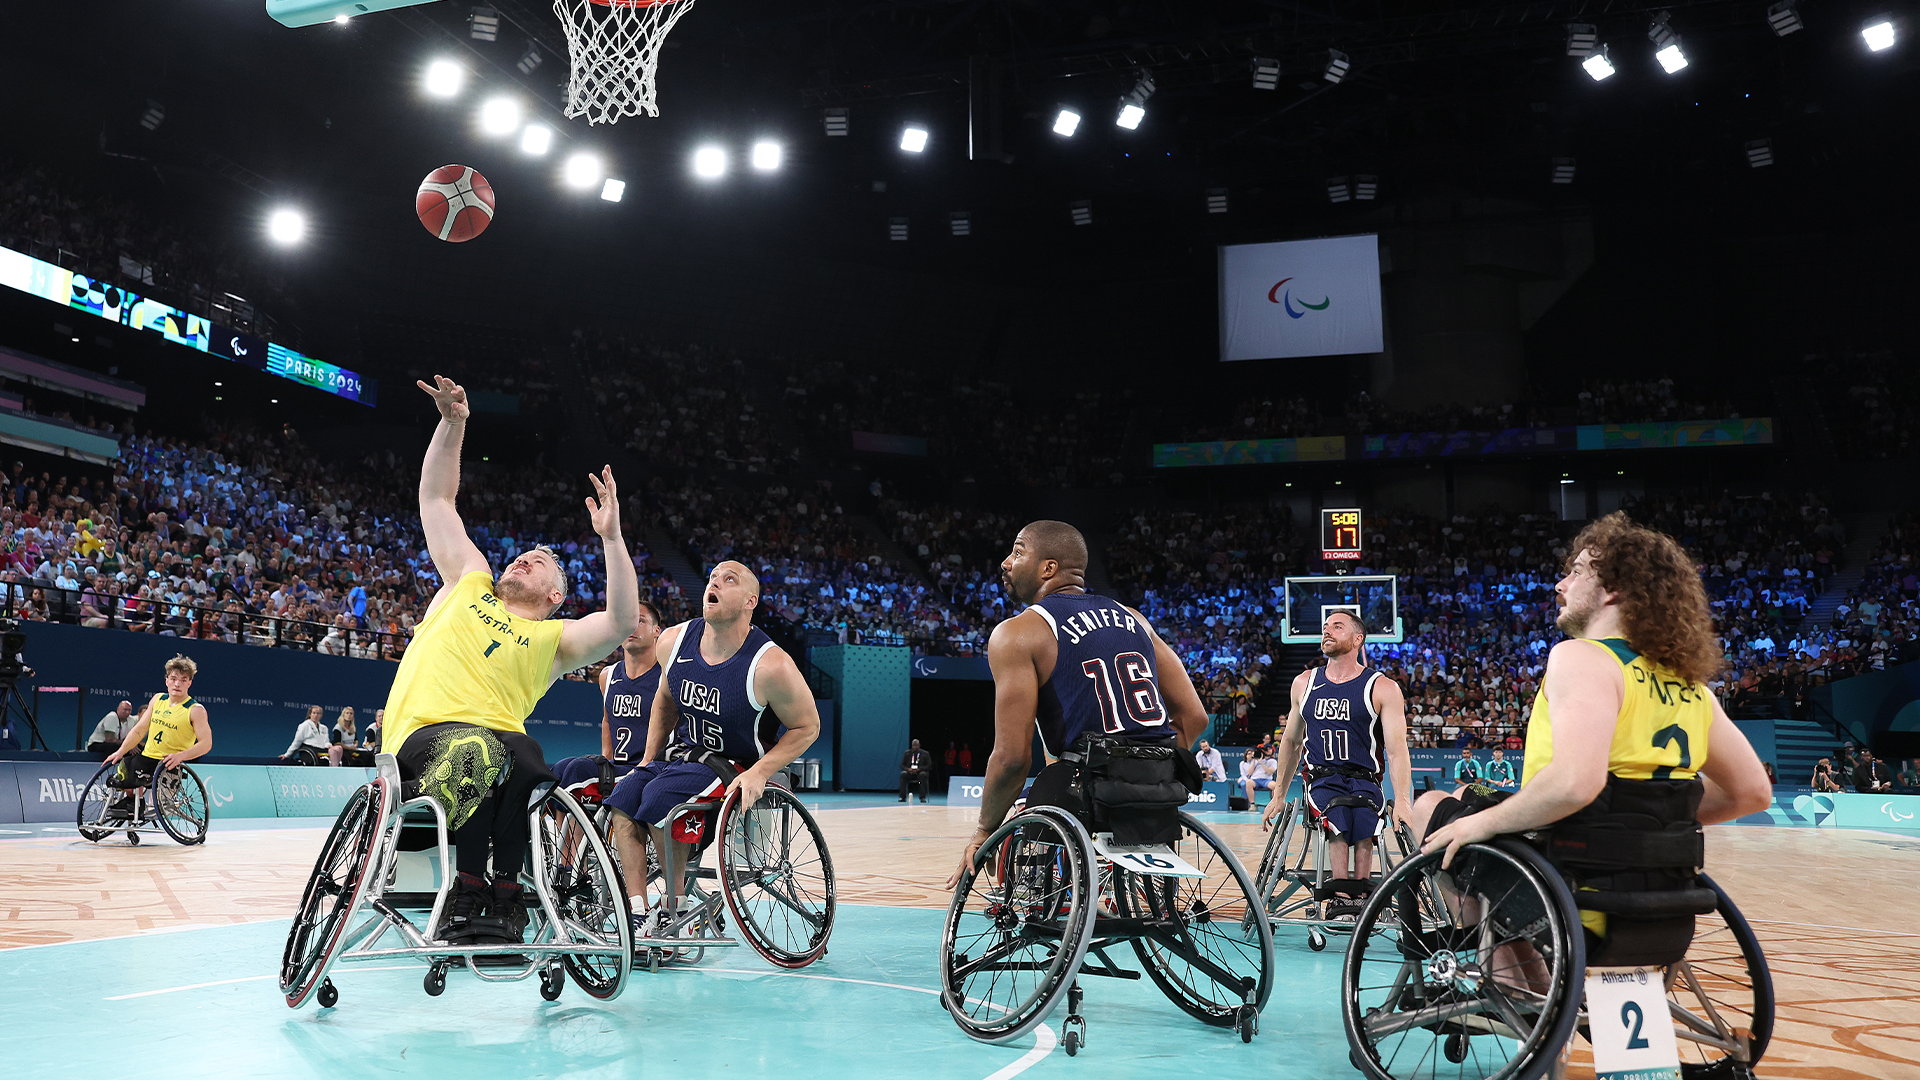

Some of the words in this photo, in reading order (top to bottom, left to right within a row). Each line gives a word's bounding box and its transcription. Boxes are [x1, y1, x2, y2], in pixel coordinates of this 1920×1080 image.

[285, 357, 325, 382] PARIS
[328, 372, 362, 394] 2024
[1331, 513, 1358, 525] 5:08
[1336, 527, 1357, 547] 17
[469, 604, 530, 649] AUSTRAIA
[1061, 608, 1136, 645] JENIFER
[483, 639, 501, 658] 1
[679, 679, 720, 715] USA
[1081, 651, 1166, 733] 16
[613, 695, 641, 717] USA
[1314, 698, 1350, 721] USA
[154, 730, 163, 744] 4
[614, 727, 631, 761] 2
[684, 712, 724, 752] 15
[1321, 729, 1349, 760] 11
[282, 784, 324, 798] PARIS
[327, 785, 358, 798] 202
[1122, 853, 1175, 869] 16
[1601, 971, 1635, 984] Allianz
[1621, 1000, 1649, 1050] 2
